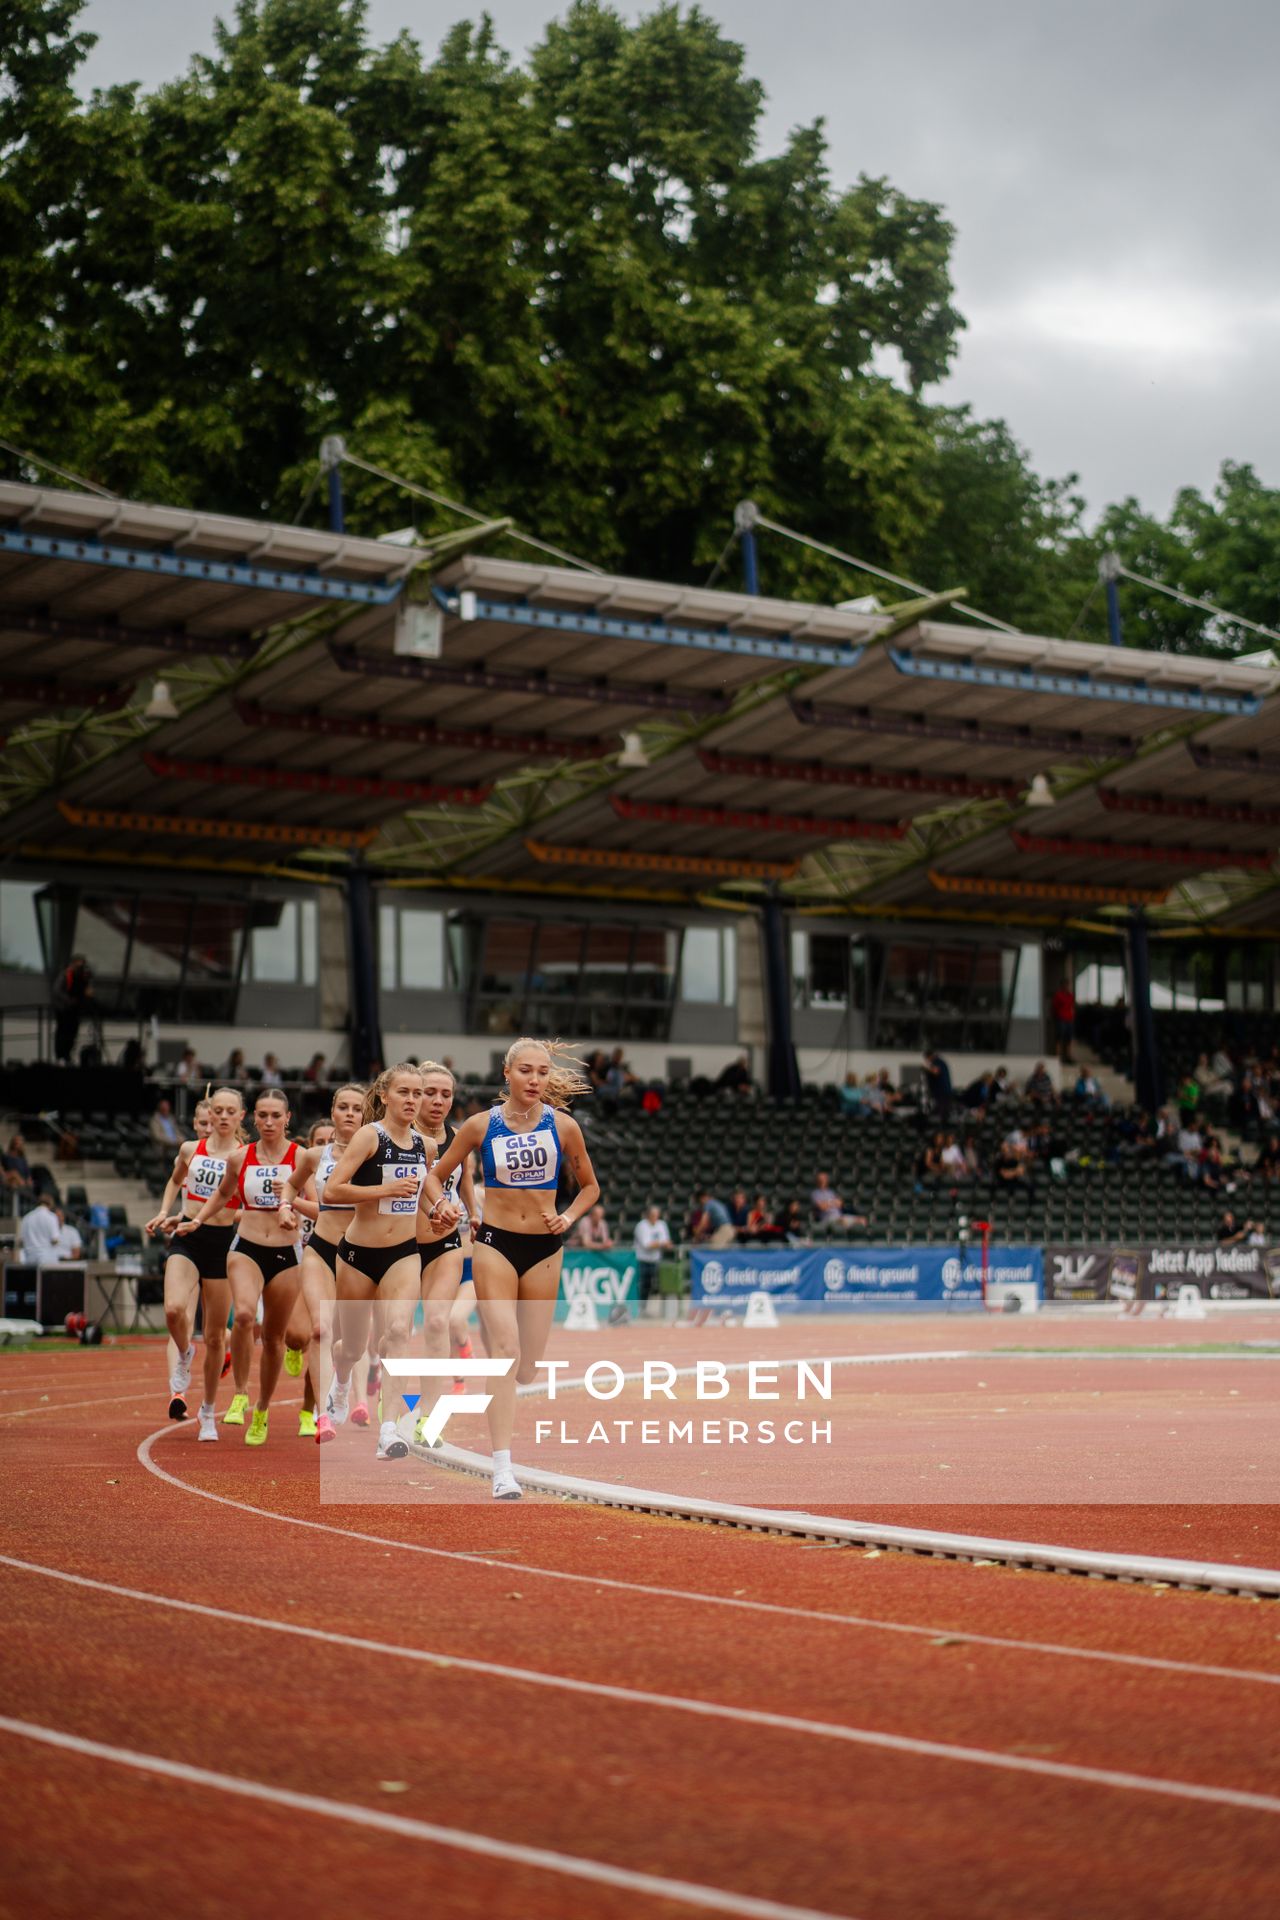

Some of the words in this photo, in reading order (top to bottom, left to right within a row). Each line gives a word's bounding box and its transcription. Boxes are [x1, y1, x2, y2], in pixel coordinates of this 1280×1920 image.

[505, 1135, 538, 1149] GLS
[202, 1159, 225, 1171] GLS
[506, 1147, 548, 1170] 590
[256, 1167, 278, 1177] GLS
[394, 1167, 418, 1179] GLS
[524, 1171, 544, 1180] PLAN
[262, 1179, 273, 1194] 8
[1148, 1248, 1184, 1272] Jetzt
[1186, 1248, 1213, 1277] App
[725, 1267, 758, 1285] direkt
[759, 1266, 800, 1290] gesund
[847, 1266, 876, 1283] direkt
[878, 1265, 918, 1287] gesund
[993, 1265, 1032, 1283] gesund
[562, 1266, 636, 1305] WGV
[576, 1302, 587, 1316] 3
[756, 1299, 765, 1313] 2
